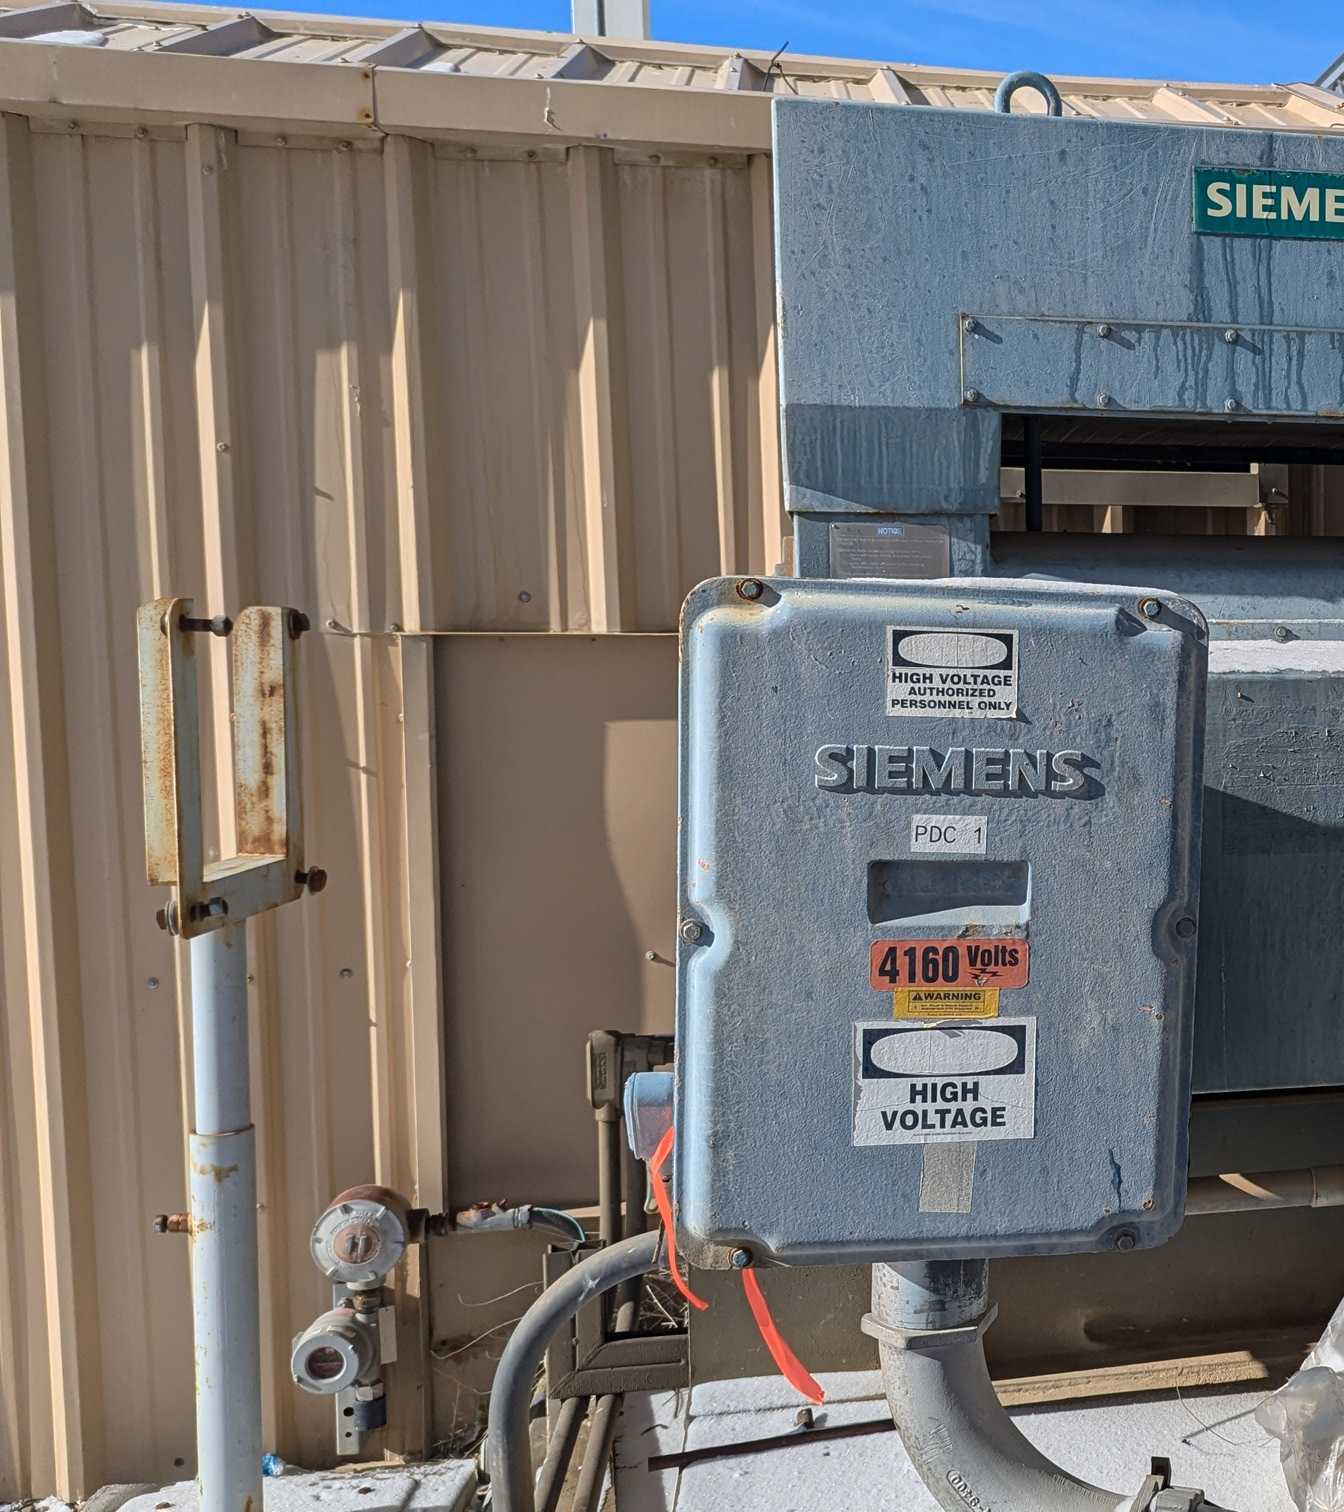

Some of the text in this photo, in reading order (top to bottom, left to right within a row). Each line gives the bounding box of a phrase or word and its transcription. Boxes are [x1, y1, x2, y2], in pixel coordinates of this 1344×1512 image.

[891, 672, 1013, 687] HIGH VOLTAGE
[908, 687, 997, 698] AUTHORIZED
[891, 699, 1013, 712] PERSONNEL ONLY
[814, 743, 1087, 793] SIEMENS
[914, 824, 983, 845] PDC 1
[878, 945, 1020, 984] 4160 Volts
[923, 992, 982, 1001] WARNING
[909, 1081, 980, 1104] HIGH
[880, 1106, 1007, 1131] VOLTAGE
